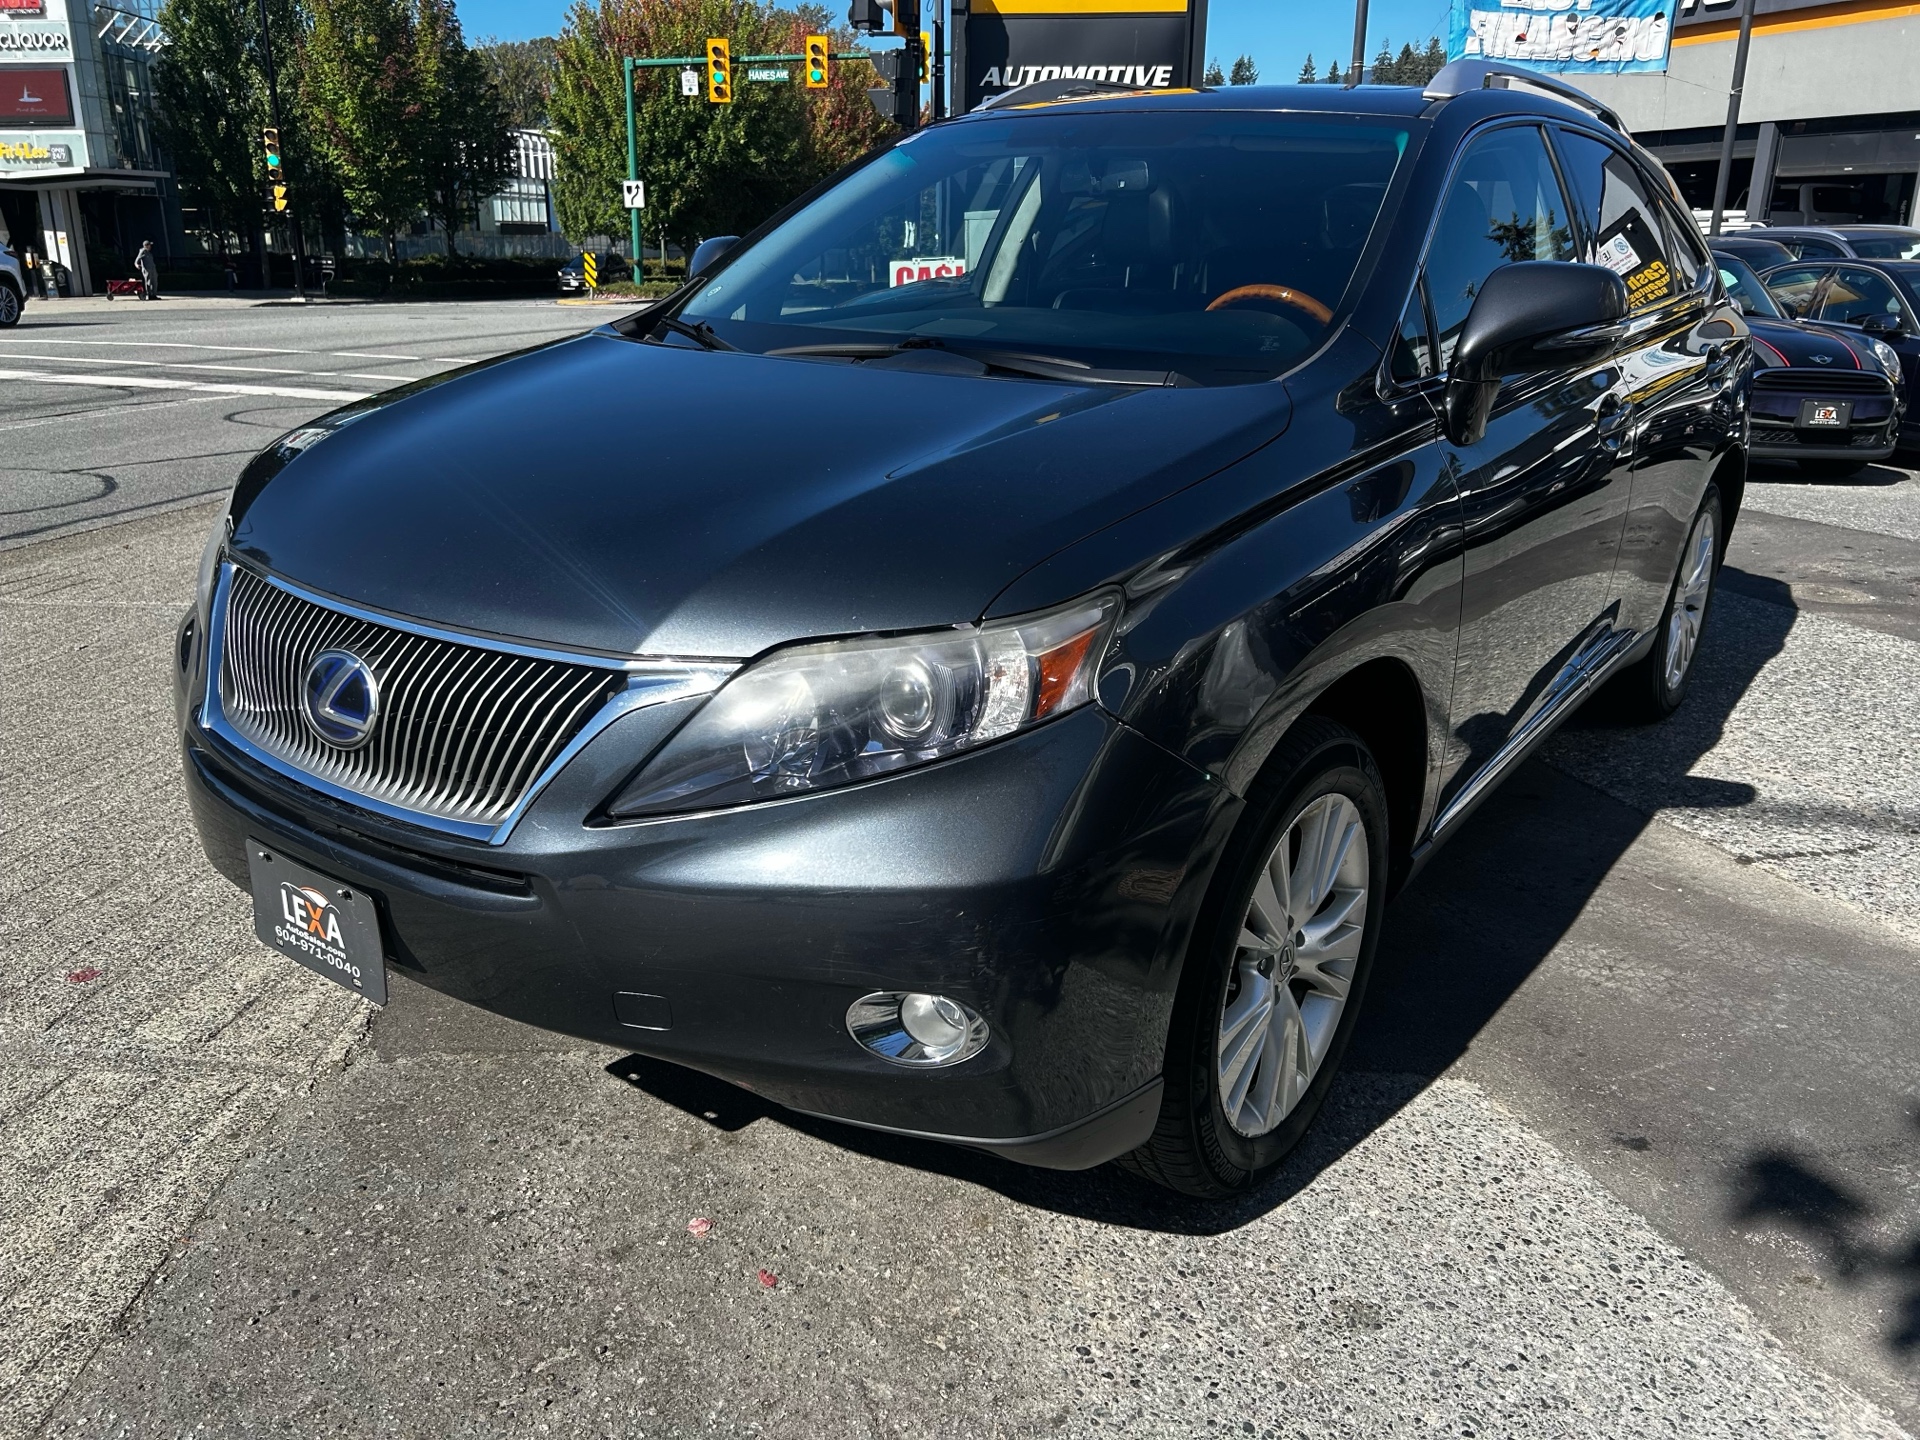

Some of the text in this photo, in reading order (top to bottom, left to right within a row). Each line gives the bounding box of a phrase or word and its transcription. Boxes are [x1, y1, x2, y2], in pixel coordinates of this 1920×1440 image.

[748, 70, 789, 80] HANES AVE
[979, 65, 1173, 87] AUTOMOTIVE
[1815, 410, 1836, 418] LEXA
[281, 888, 346, 950] LEXA
[274, 925, 361, 978] 604-971-0040
[286, 922, 347, 960] AutoSales.com
